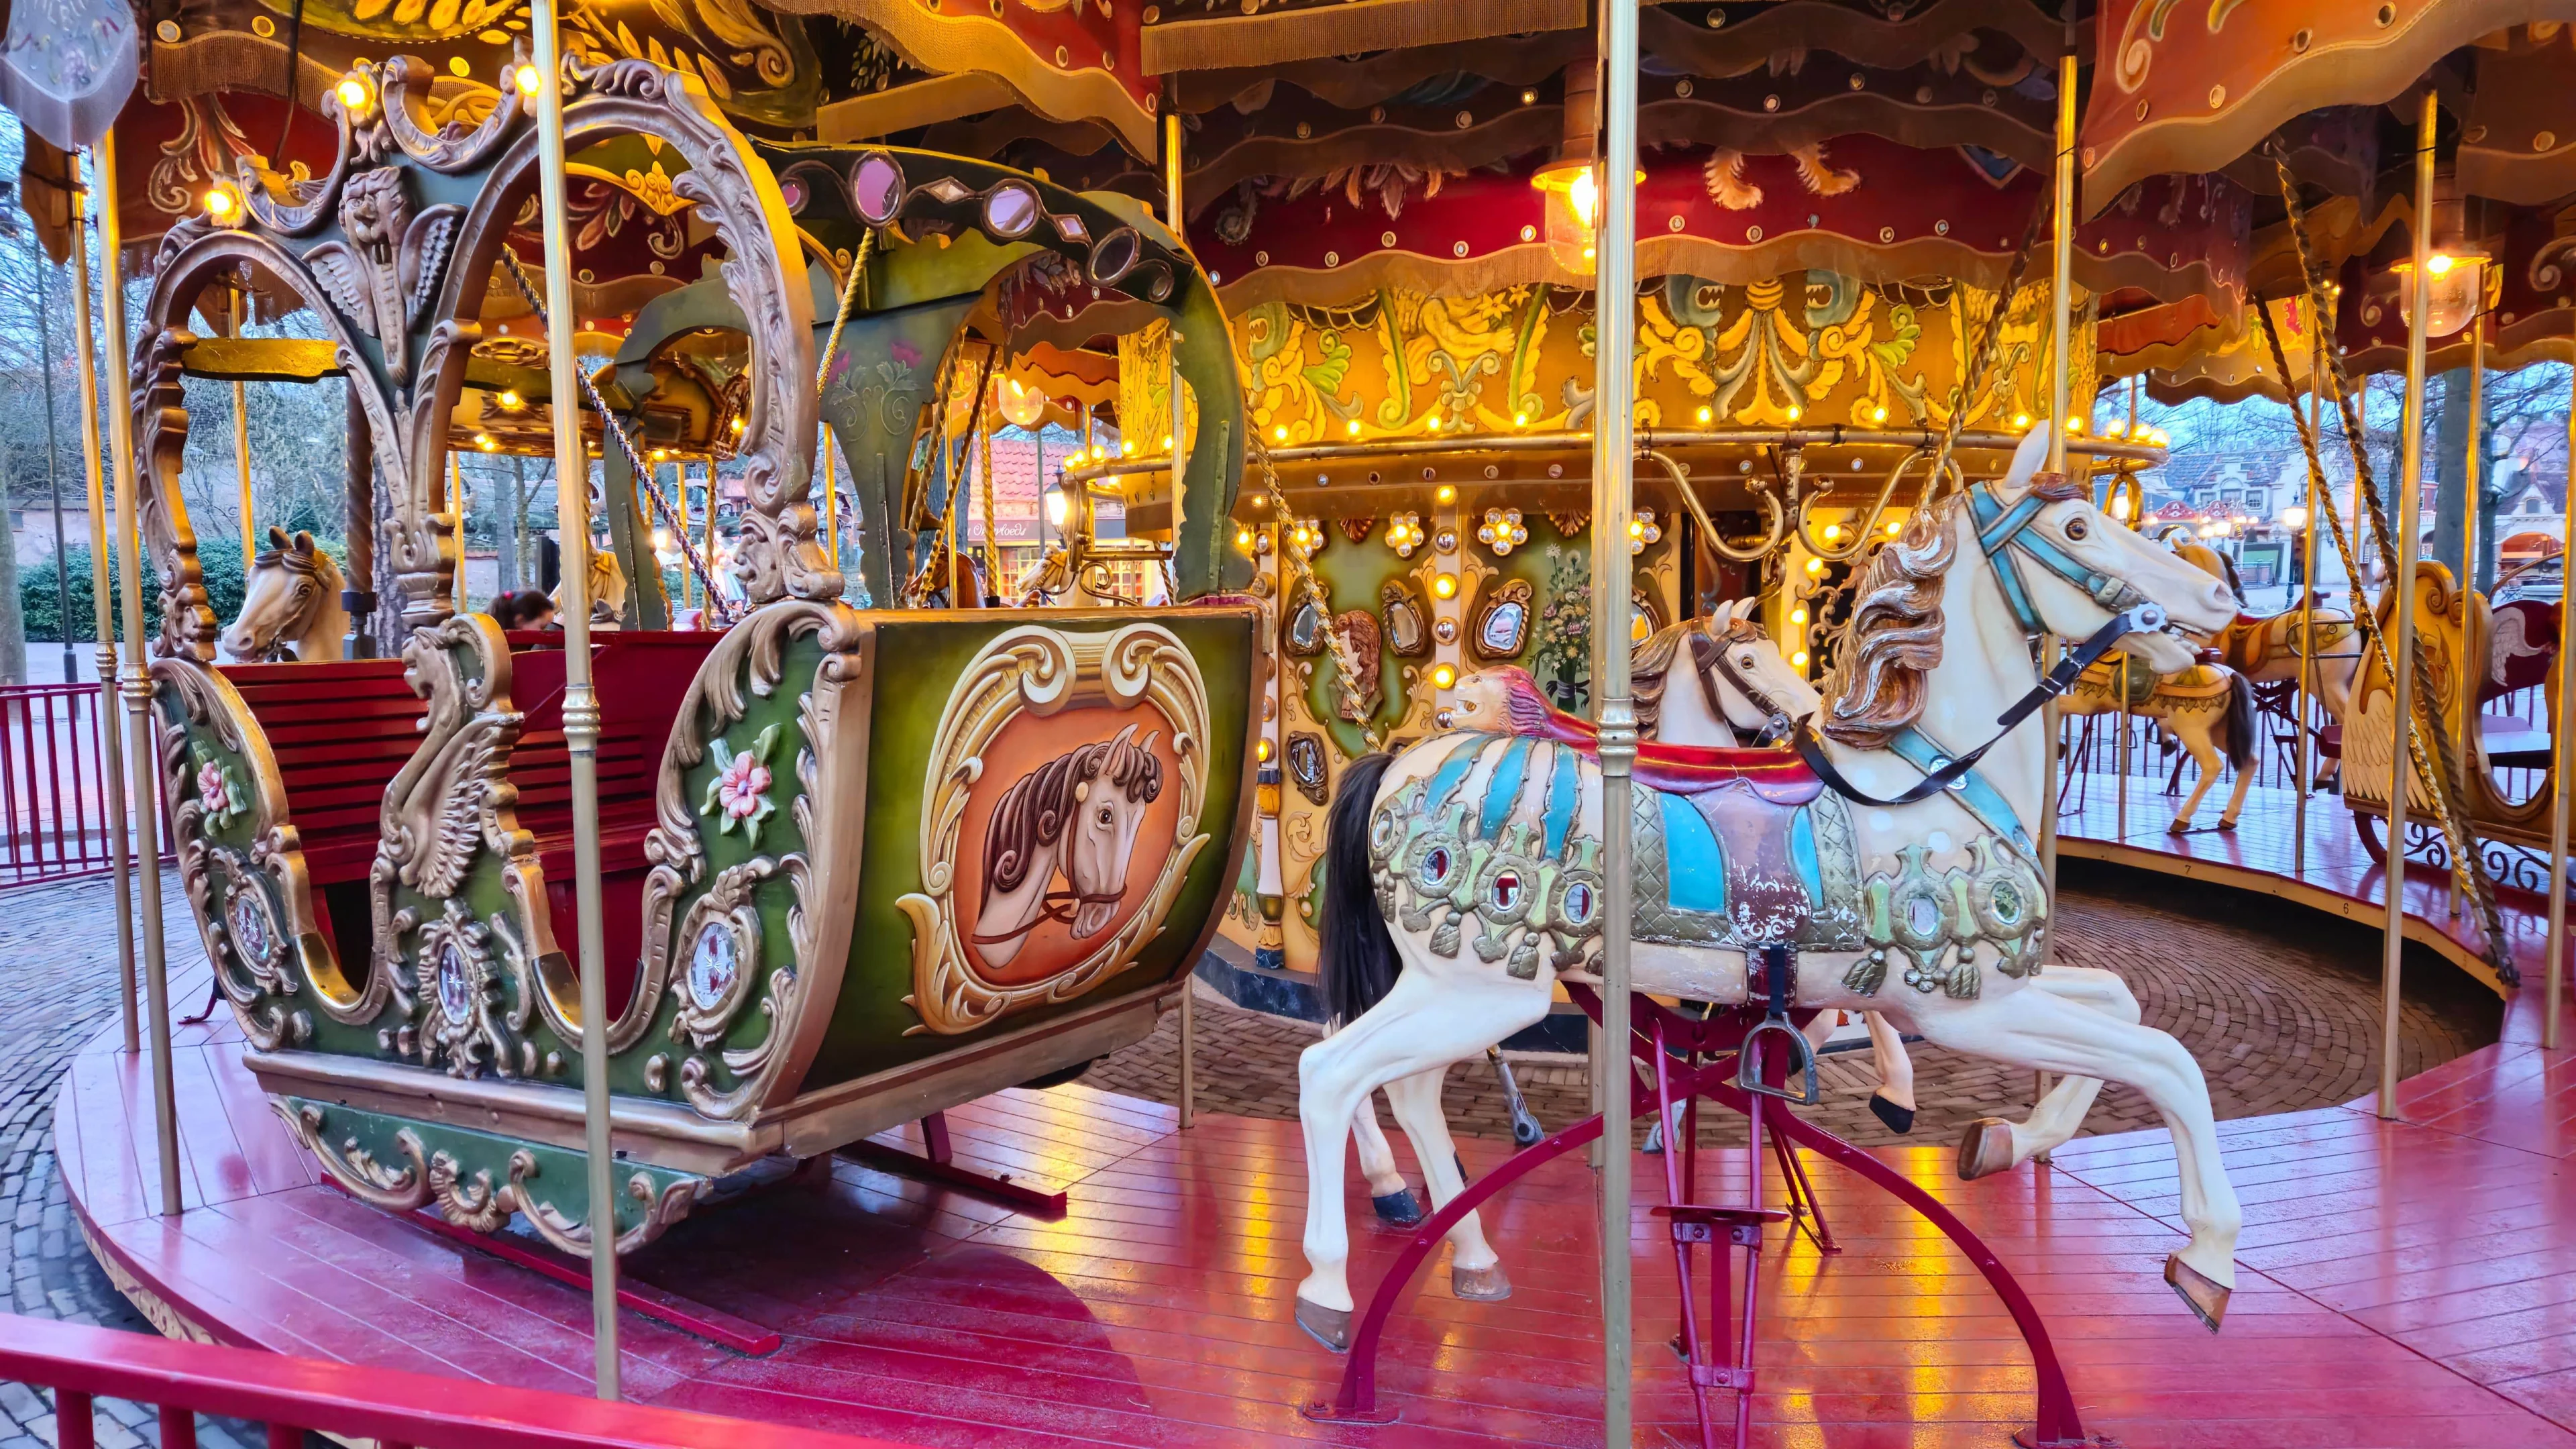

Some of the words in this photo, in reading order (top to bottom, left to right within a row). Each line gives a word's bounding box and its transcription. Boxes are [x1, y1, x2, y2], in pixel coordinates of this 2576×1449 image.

[973, 523, 1026, 536] Ovloeds
[2185, 865, 2191, 875] 7
[2343, 902, 2349, 914] 6
